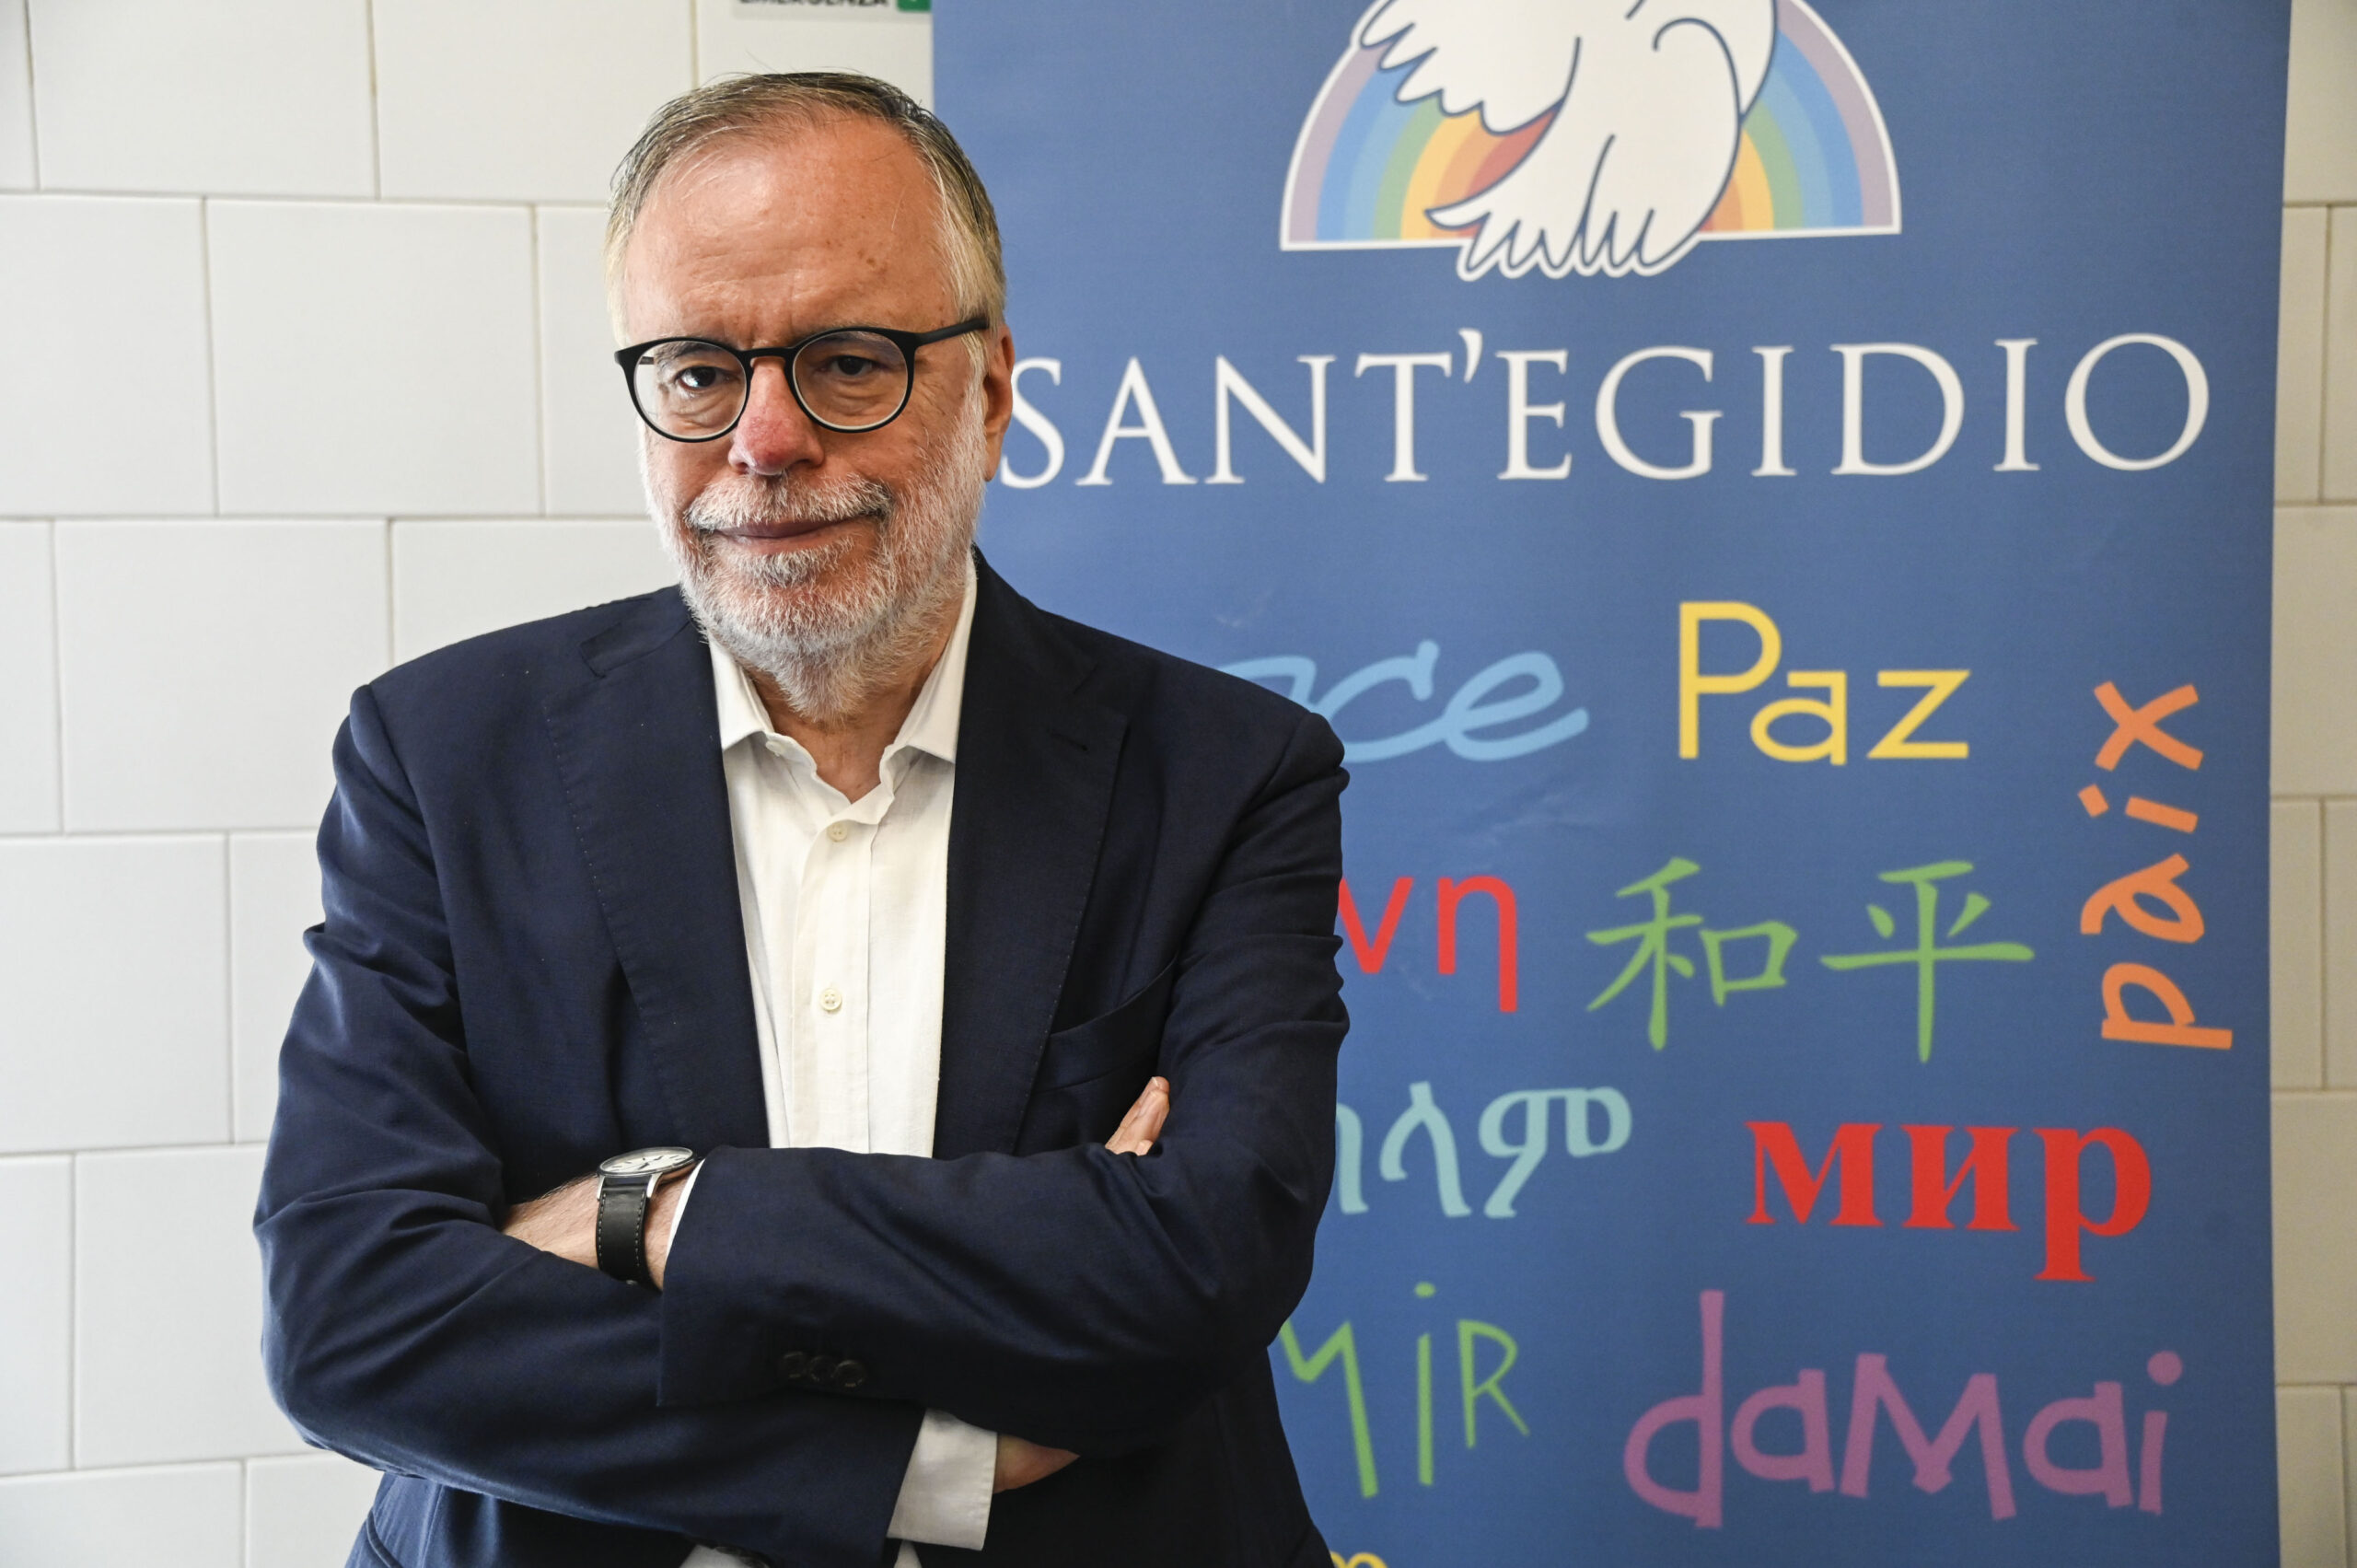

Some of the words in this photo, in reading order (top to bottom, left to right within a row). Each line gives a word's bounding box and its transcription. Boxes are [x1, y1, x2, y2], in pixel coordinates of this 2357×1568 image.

[999, 330, 2210, 490] SANT'EGIDIO
[1678, 600, 1972, 766] Paz
[2077, 680, 2235, 1051] paix
[1585, 857, 2037, 1063] 和平
[1744, 1121, 2154, 1283] мир
